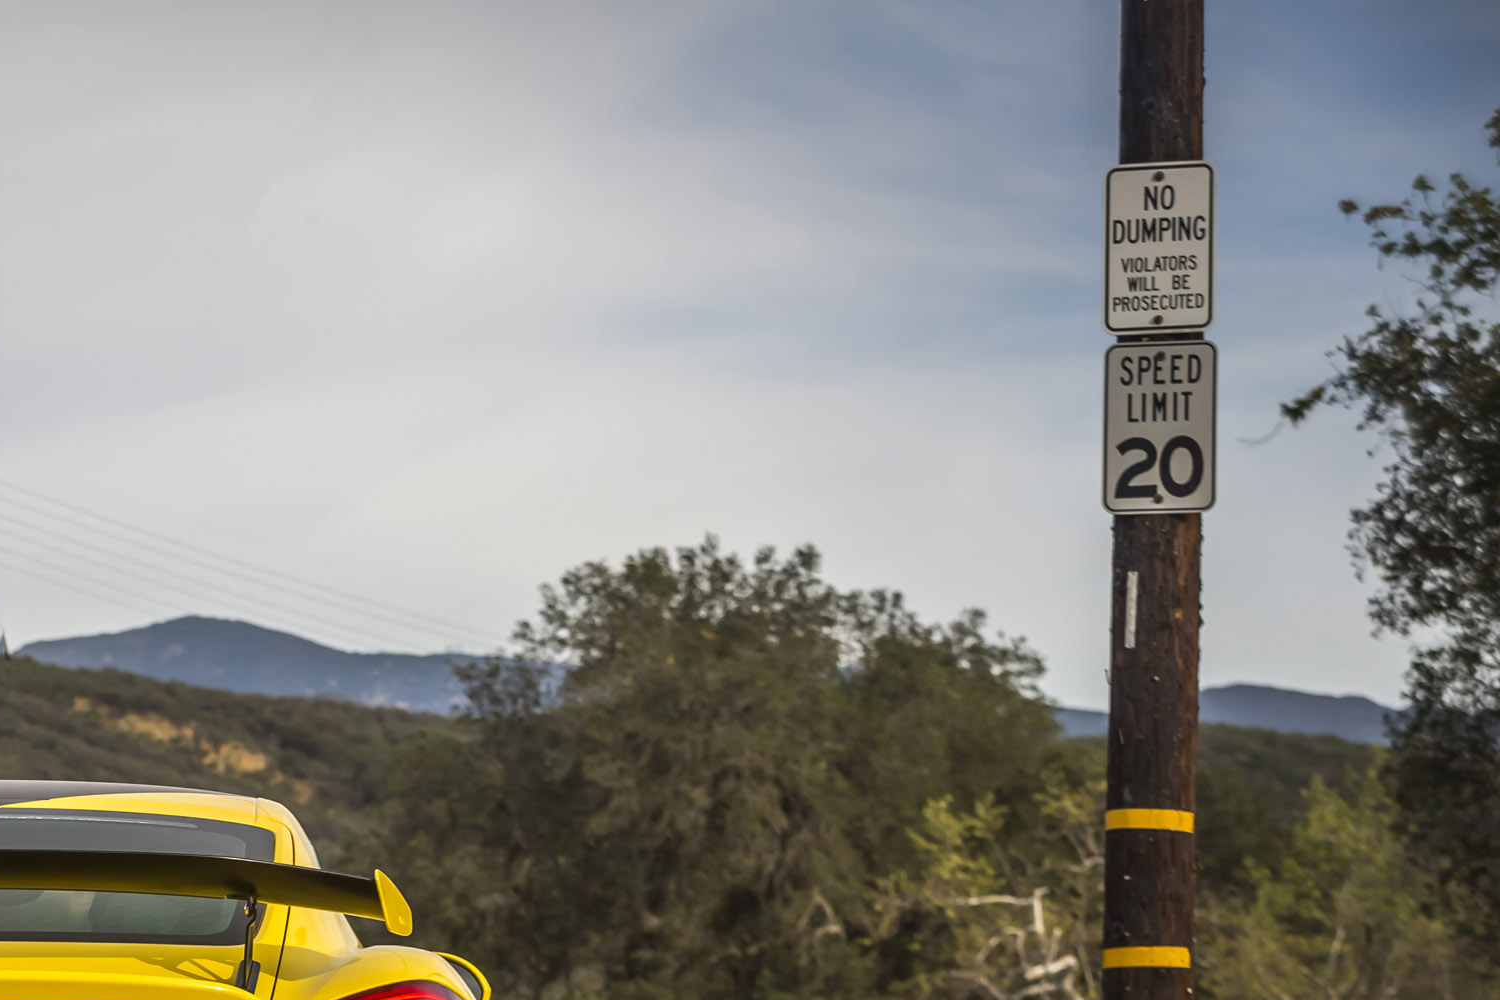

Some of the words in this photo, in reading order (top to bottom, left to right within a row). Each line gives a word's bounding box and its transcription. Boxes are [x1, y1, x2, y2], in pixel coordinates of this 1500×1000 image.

[1143, 184, 1175, 211] NO
[1112, 215, 1206, 244] DUMPING
[1120, 255, 1197, 273] VIOLATORS
[1127, 276, 1160, 292] WILL
[1171, 274, 1191, 290] BE
[1112, 293, 1204, 312] PROSECUTED
[1119, 354, 1202, 386] SPEED
[1127, 391, 1193, 422] LIMIT
[1114, 435, 1204, 499] 20
